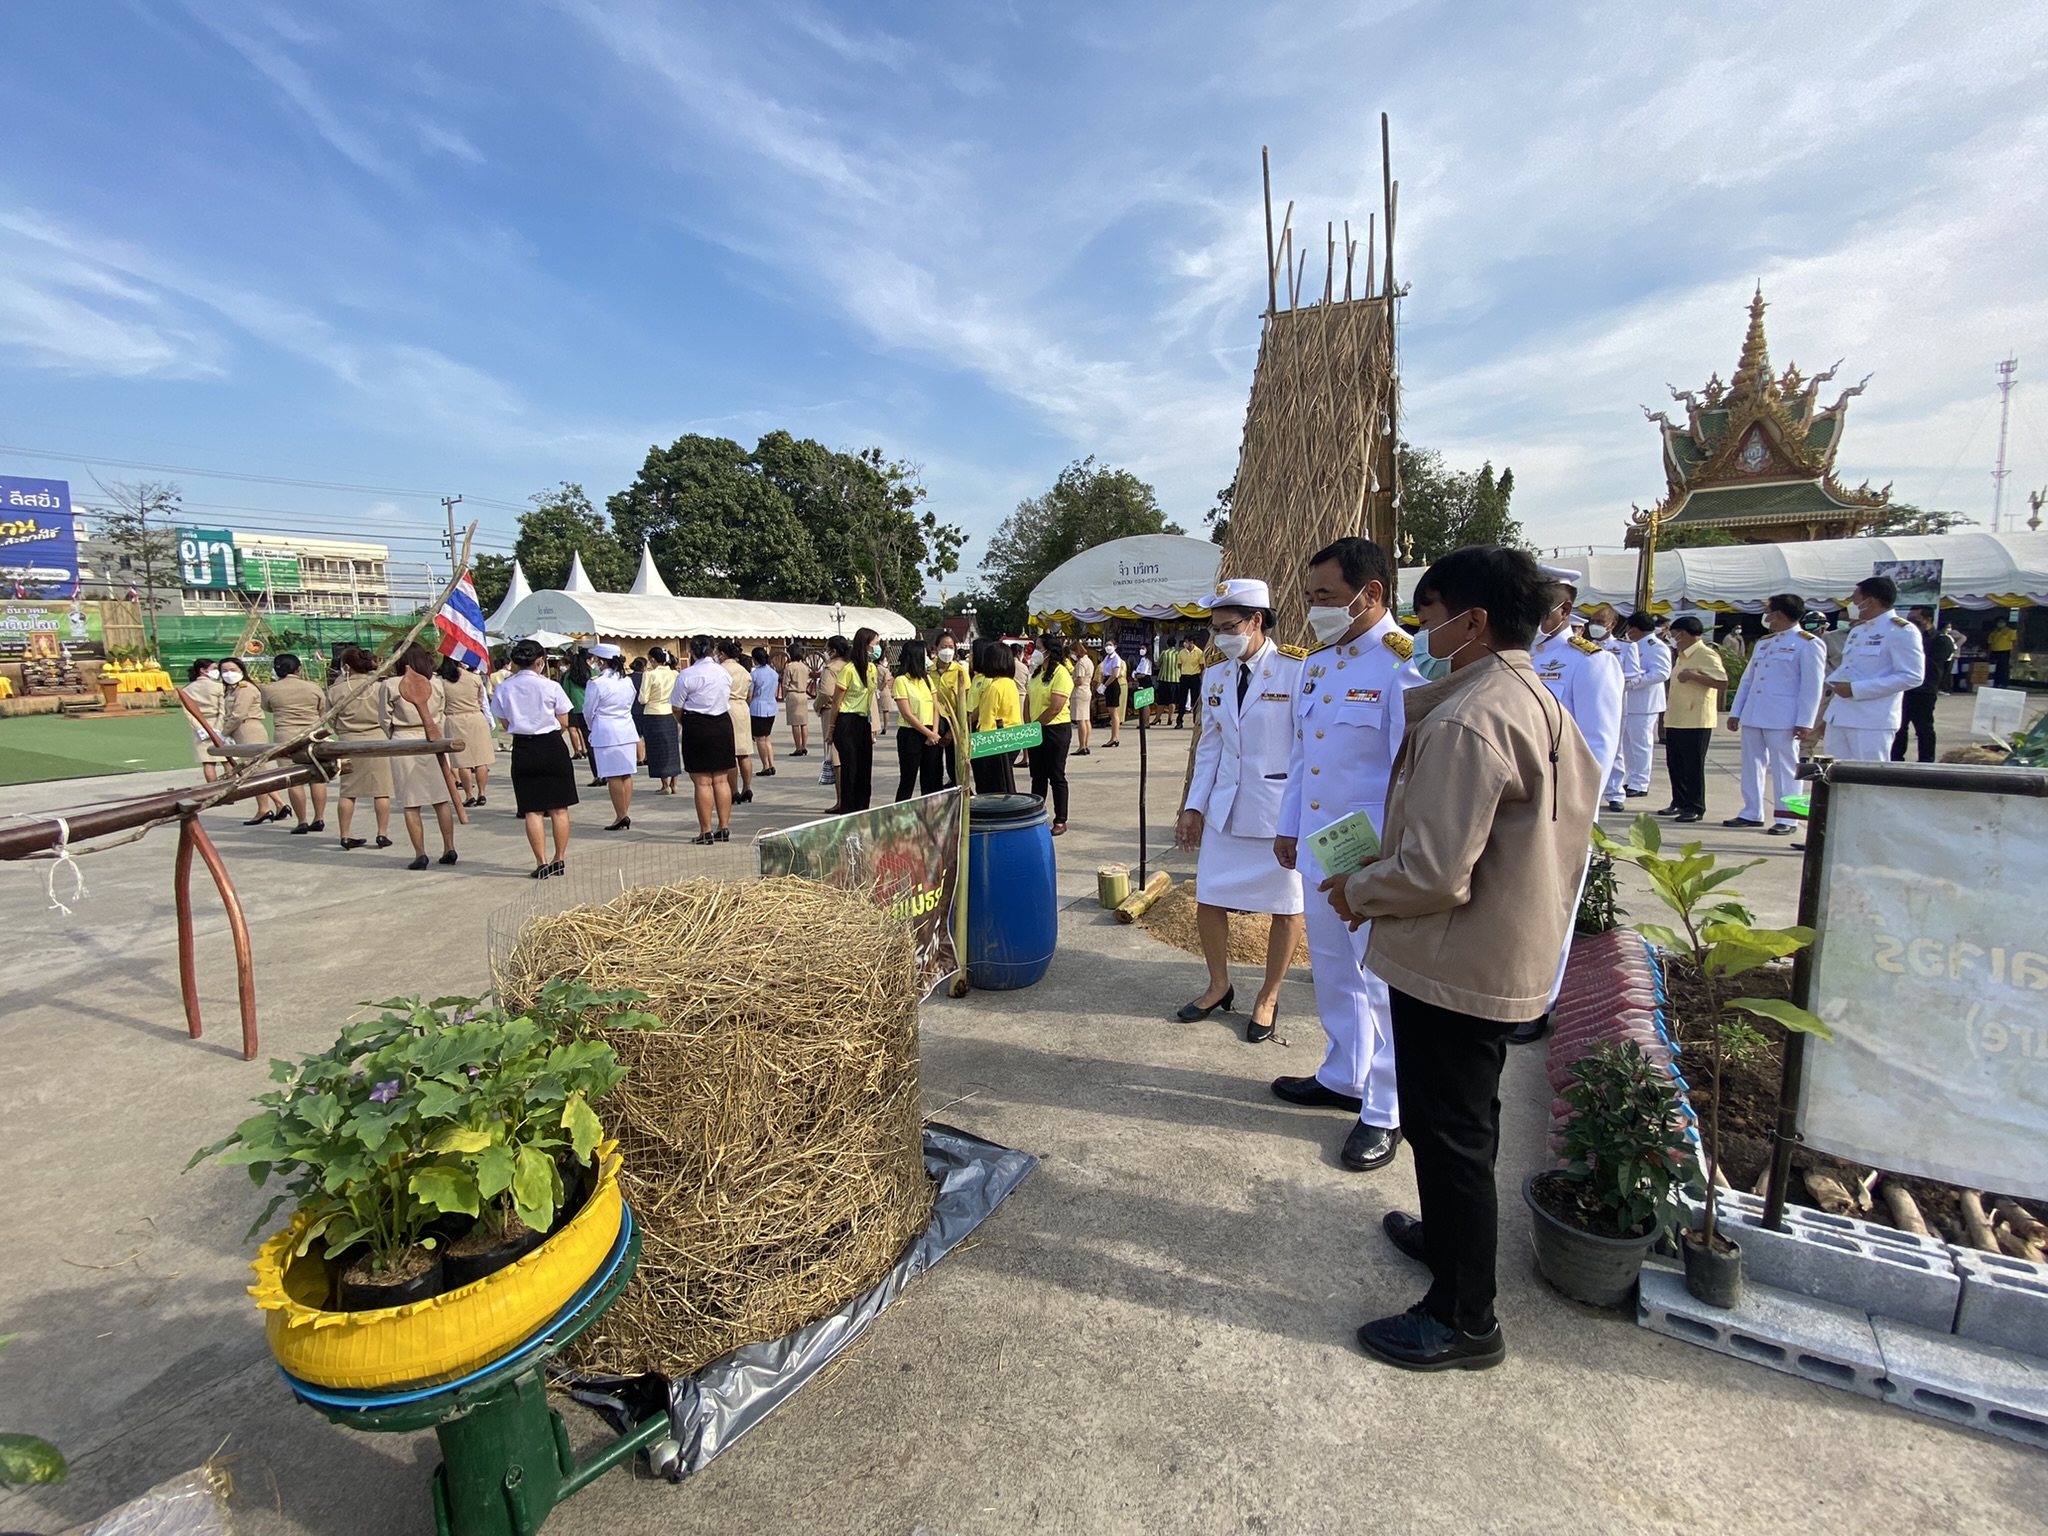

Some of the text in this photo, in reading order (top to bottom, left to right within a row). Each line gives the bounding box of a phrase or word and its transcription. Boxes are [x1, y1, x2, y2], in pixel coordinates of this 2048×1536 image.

[10, 488, 60, 508] ลีสซิ่ง
[1133, 562, 1159, 575] บริการ
[6, 605, 48, 614] ธันวาคม
